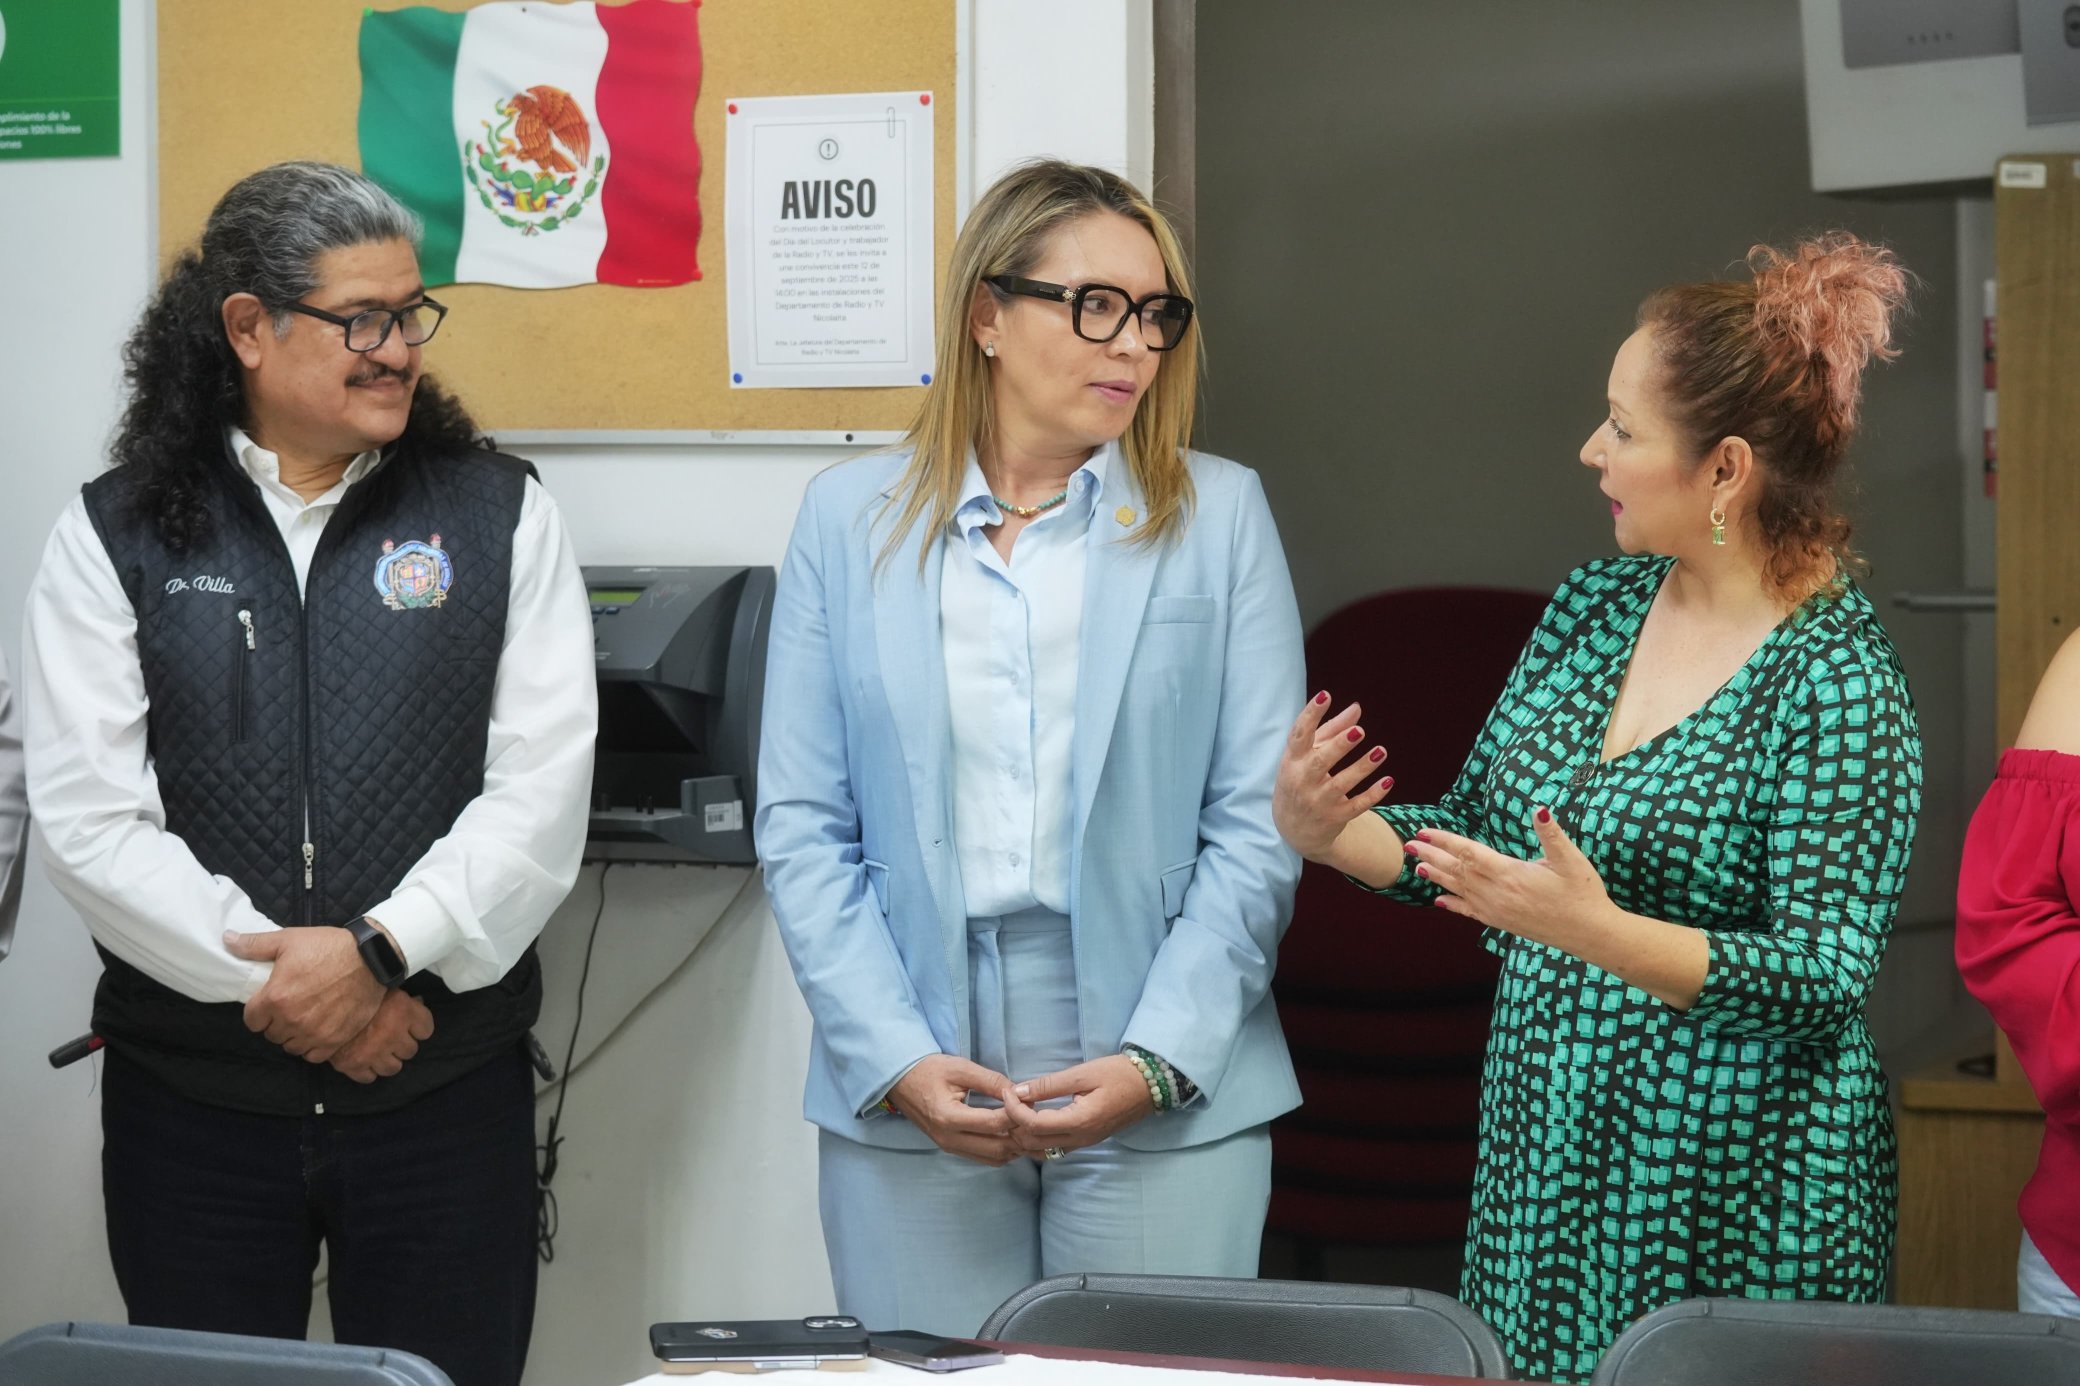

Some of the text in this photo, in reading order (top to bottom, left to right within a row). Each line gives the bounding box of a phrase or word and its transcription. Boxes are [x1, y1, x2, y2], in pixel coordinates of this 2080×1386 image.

[47, 110, 60, 121] de
[781, 178, 876, 220] AVISO
[773, 225, 789, 233] Con
[819, 224, 830, 232] de
[831, 224, 839, 232] la
[798, 237, 809, 245] del
[811, 237, 840, 245] Locutor
[772, 250, 782, 258] de
[784, 250, 791, 258] la
[792, 250, 814, 258] Radio
[860, 248, 880, 256] invita
[795, 262, 840, 270] convivencia
[870, 261, 880, 269] de
[781, 275, 825, 285] septiembre
[827, 275, 837, 283] de
[839, 275, 859, 283] 2025
[821, 287, 871, 296] instalaciones
[775, 301, 830, 311] Departamento
[832, 301, 842, 309] de
[844, 300, 866, 309] Radio
[874, 299, 885, 308] TV
[193, 575, 236, 594] Villa
